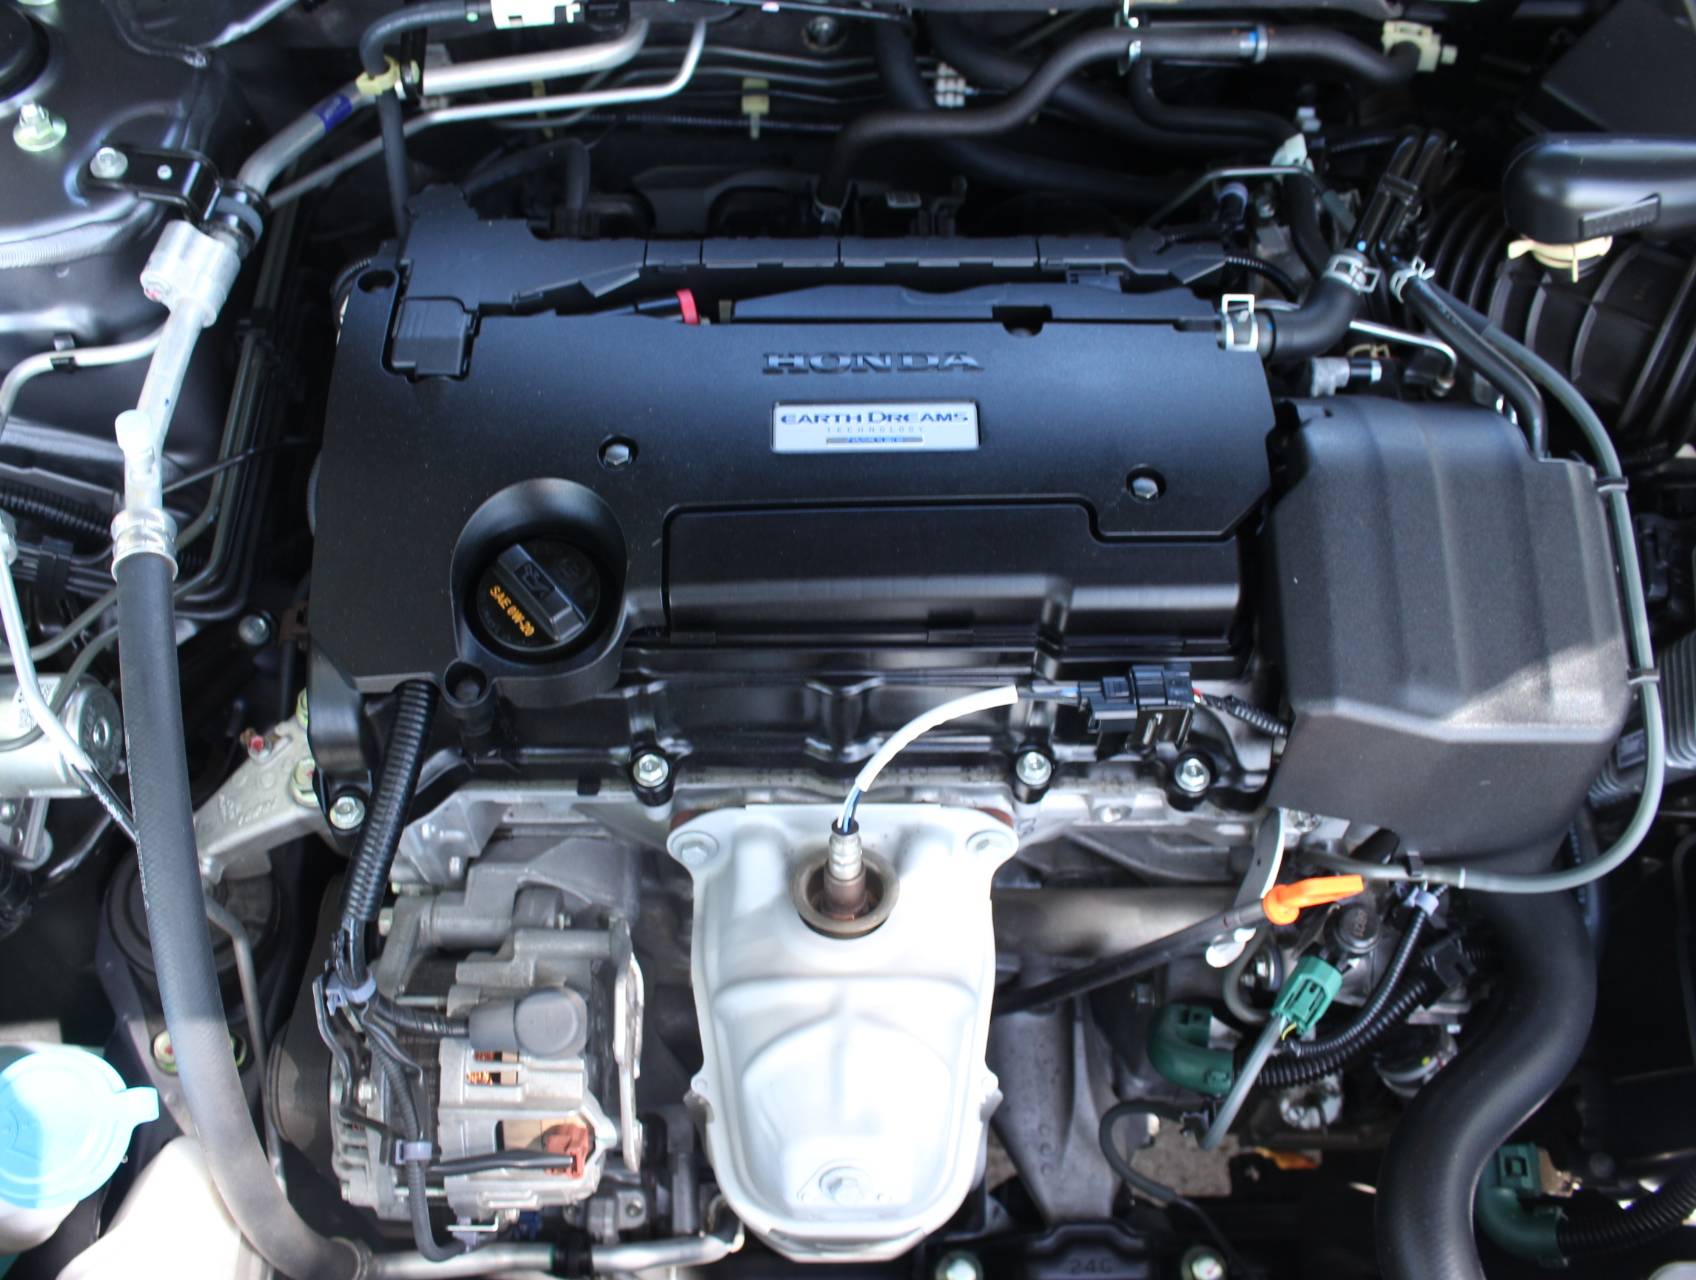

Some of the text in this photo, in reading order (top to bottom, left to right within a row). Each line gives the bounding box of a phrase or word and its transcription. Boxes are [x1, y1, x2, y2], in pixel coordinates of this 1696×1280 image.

[762, 352, 985, 374] HONDA
[780, 411, 968, 423] EARTH DREAMS
[489, 584, 536, 638] SAE 0W-20
